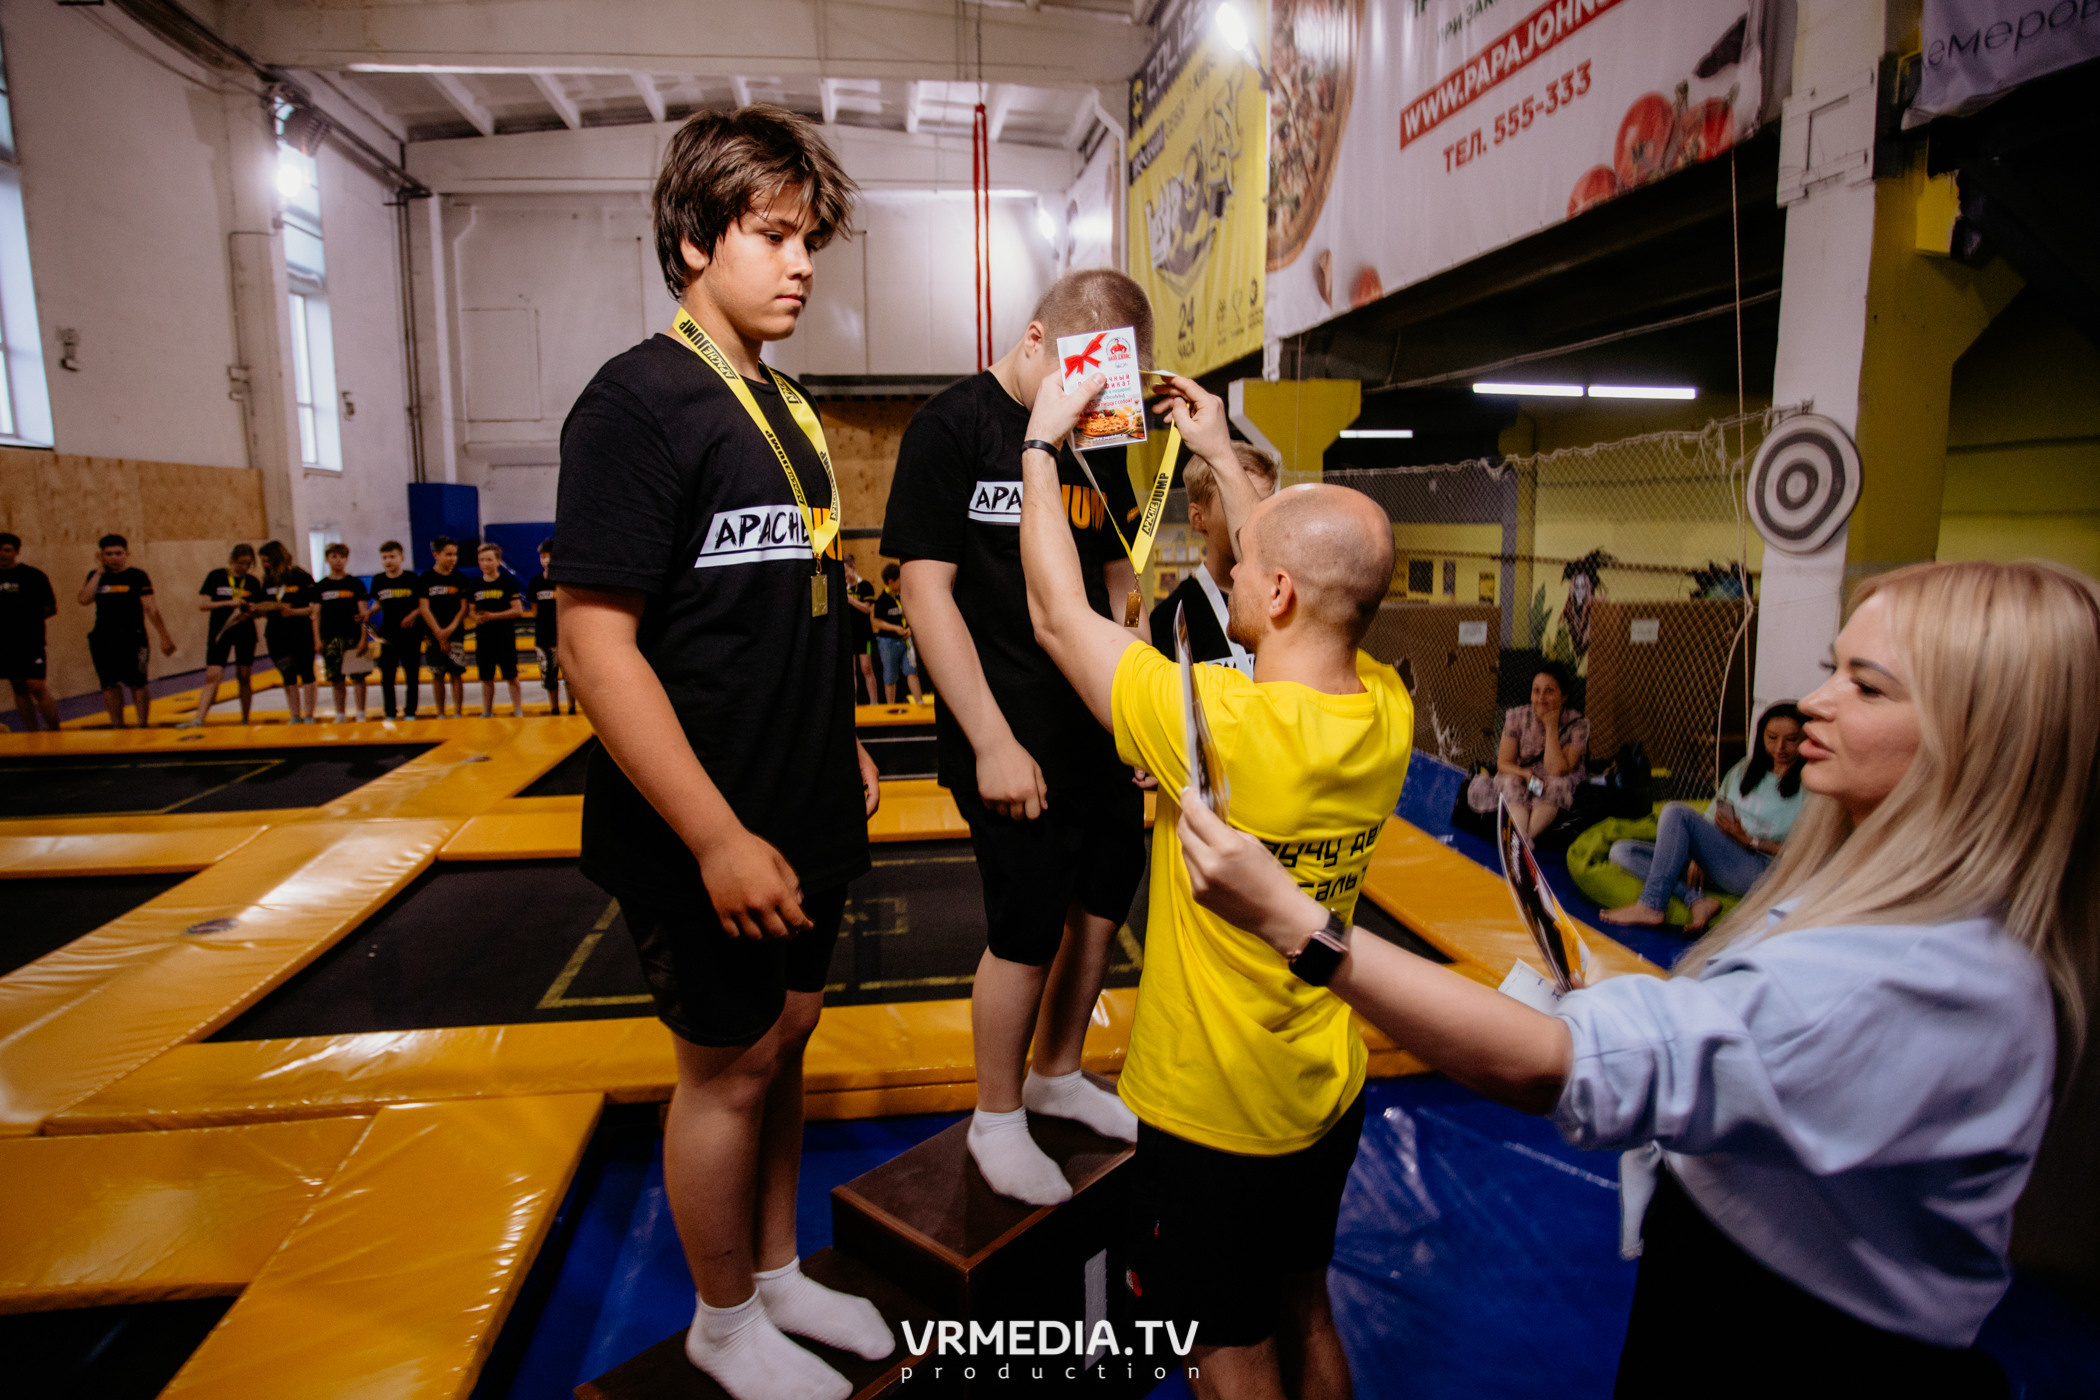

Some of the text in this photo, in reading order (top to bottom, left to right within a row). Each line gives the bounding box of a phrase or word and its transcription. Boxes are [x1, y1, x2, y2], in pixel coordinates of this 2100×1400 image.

[1443, 57, 1592, 174] ТЕЛ. 555-333
[1178, 295, 1195, 341] 24
